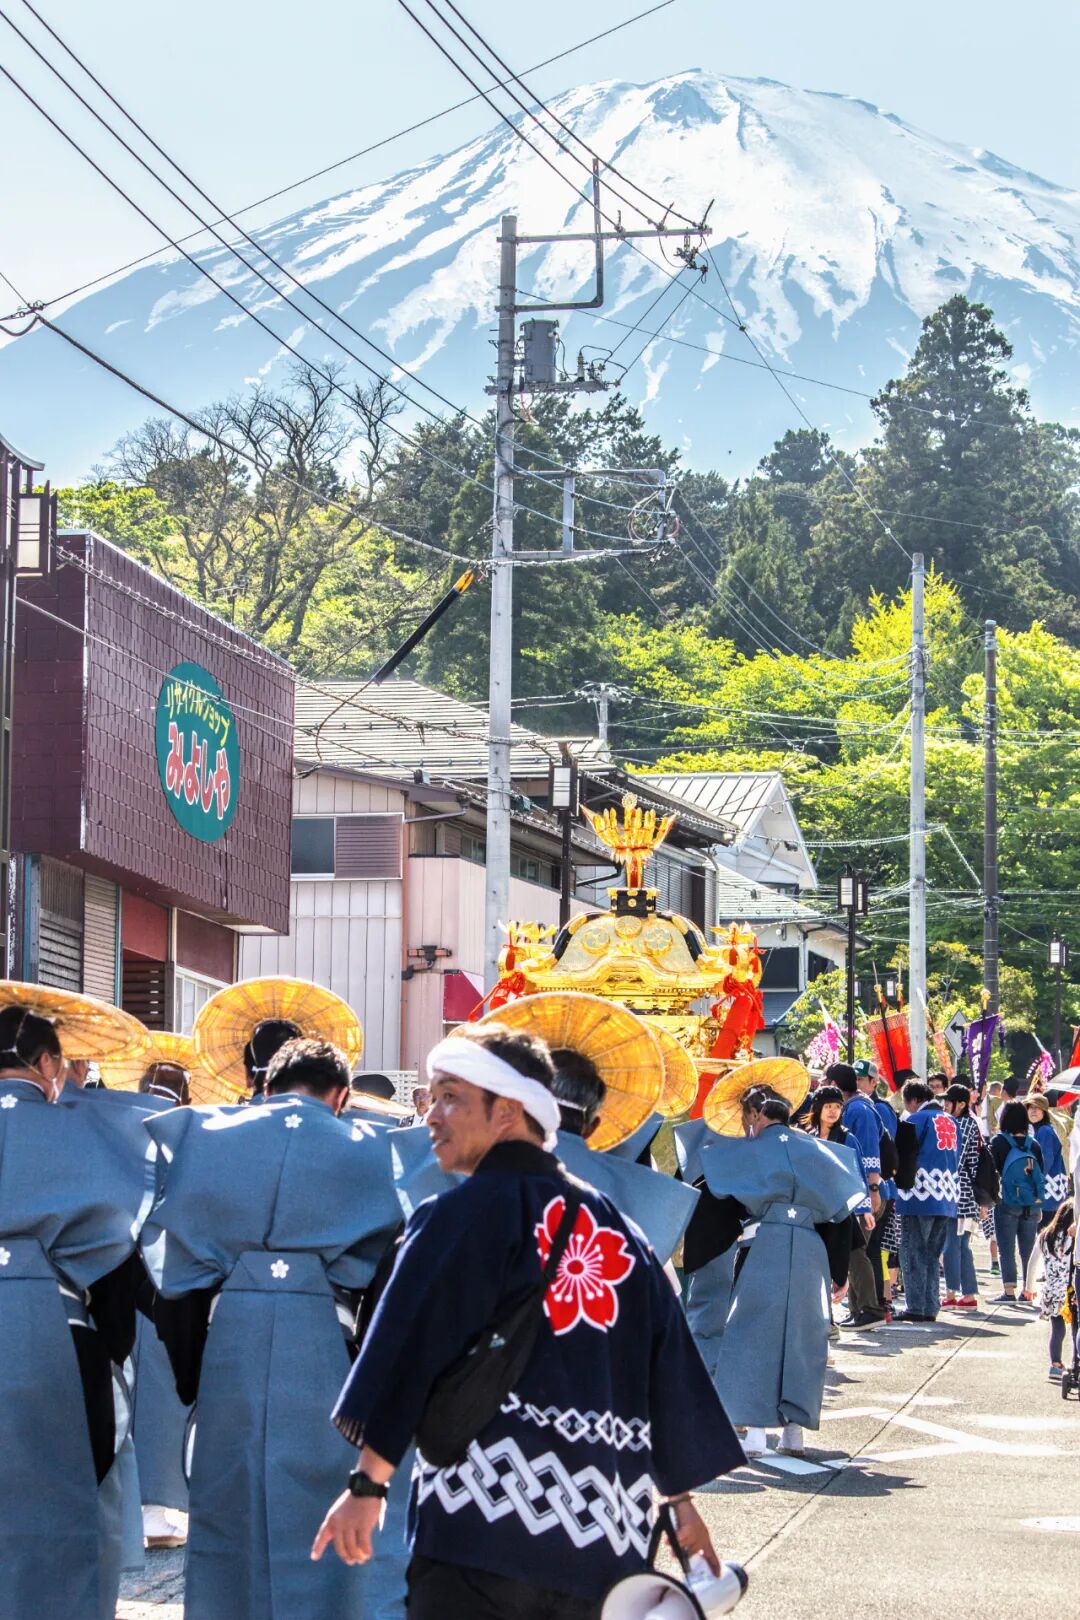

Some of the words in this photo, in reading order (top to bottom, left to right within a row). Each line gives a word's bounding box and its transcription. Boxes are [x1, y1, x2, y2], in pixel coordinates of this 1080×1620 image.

[167, 680, 230, 747] リサイクルショップ
[166, 721, 231, 820] みよしや
[932, 1113, 958, 1151] 祭
